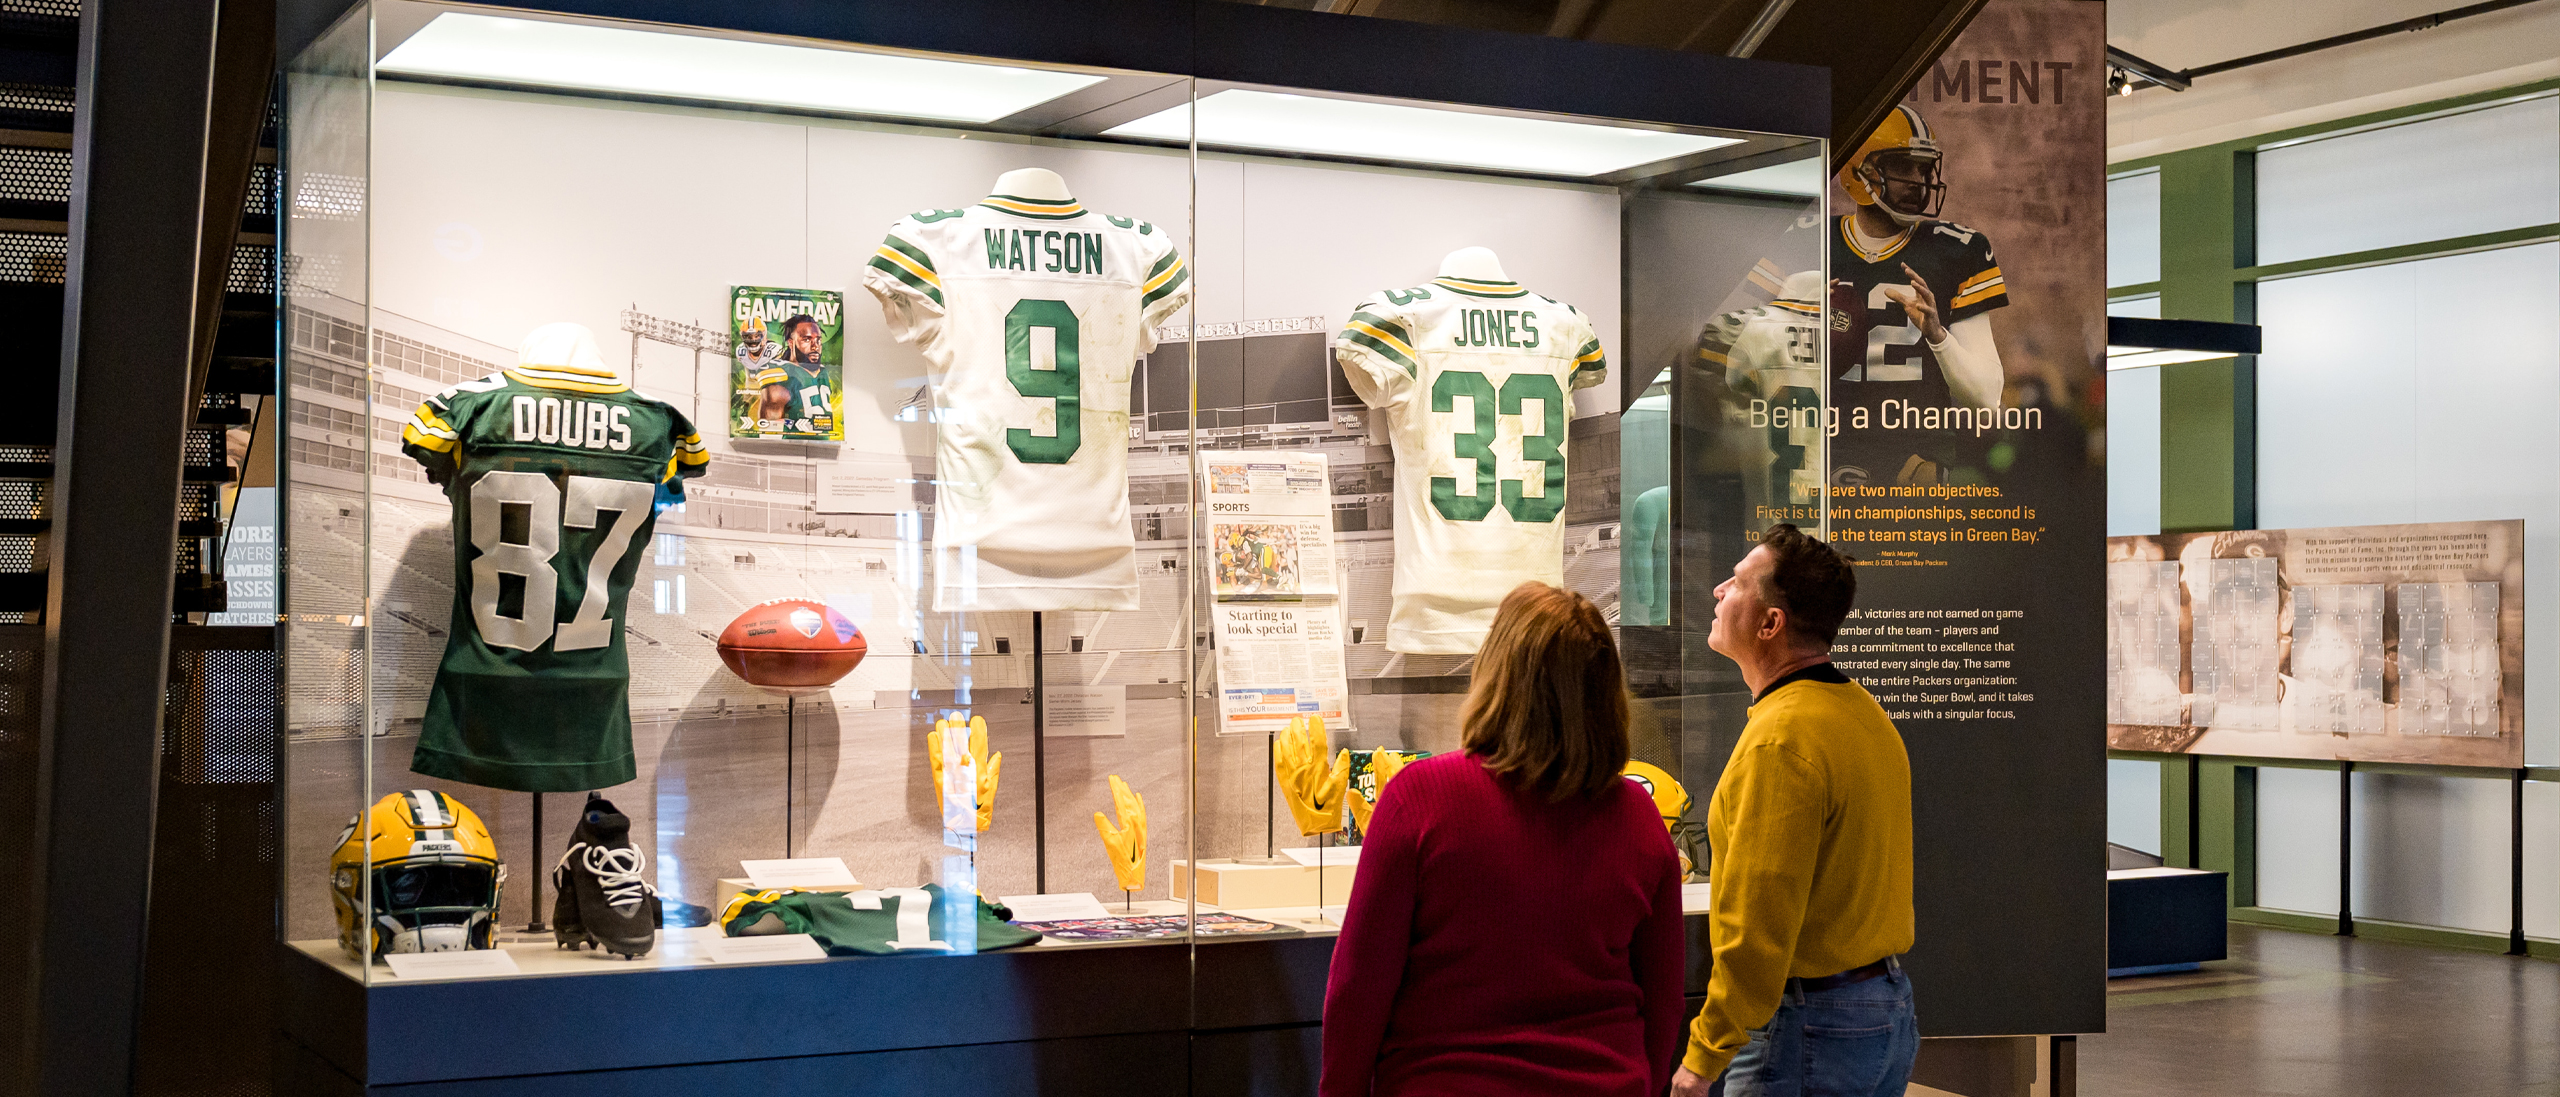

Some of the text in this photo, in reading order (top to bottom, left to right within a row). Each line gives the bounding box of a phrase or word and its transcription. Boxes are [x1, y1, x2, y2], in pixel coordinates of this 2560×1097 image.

[1909, 59, 2073, 105] MENT
[984, 228, 1103, 275] WATSON
[735, 296, 840, 326] GAMEDAY
[1254, 318, 1301, 334] FIELD
[1454, 308, 1540, 349] JONES
[1004, 298, 1081, 465] 9
[513, 395, 632, 451] DOUBS
[1750, 398, 2042, 438] Being a Champion
[1430, 370, 1566, 523] 33
[1859, 484, 1886, 498] two
[1889, 483, 1925, 498] main
[1928, 483, 2004, 501] objectives.
[1212, 503, 1250, 513] SPORTS
[1756, 505, 1789, 520] First
[1792, 505, 1804, 520] is
[1829, 505, 1851, 520] win
[1854, 505, 1966, 523] championships,
[1970, 505, 2021, 520] second
[2024, 505, 2036, 520] is
[229, 526, 274, 544] ORE
[1745, 529, 1760, 542] to
[1841, 528, 1866, 542] the
[1868, 529, 1906, 542] team
[1909, 529, 1947, 545] stays
[1950, 528, 1963, 542] in
[1966, 528, 2008, 542] Green
[2329, 537, 2349, 545] support
[1880, 550, 1919, 559] Mark Murphy
[2315, 547, 2337, 555] Packers
[2338, 546, 2349, 554] Hall
[2387, 545, 2409, 553] through
[2421, 545, 2437, 553] years
[470, 470, 656, 652] 87
[1880, 559, 1894, 568] CEO,
[1894, 559, 1913, 567] Green
[1913, 559, 1925, 568] Bay
[1925, 559, 1948, 567] Packers
[2330, 556, 2351, 564] mission
[2359, 555, 2383, 564] preserve
[2384, 554, 2394, 562] the
[2395, 553, 2415, 562] history
[2435, 552, 2452, 560] Green
[2453, 552, 2464, 561] Bay
[2465, 551, 2489, 560] Packers
[225, 564, 274, 577] AMES
[2340, 565, 2362, 573] national
[2411, 563, 2445, 571] educational
[214, 612, 275, 625] CATCHES
[1229, 610, 1293, 623] Starting to
[1864, 608, 2024, 621] victories are not earned on game
[1227, 622, 1298, 637] look special
[1874, 625, 1885, 636] of
[1887, 625, 1904, 636] the
[1906, 626, 1932, 636] team
[1943, 625, 1979, 637] players
[1980, 625, 1999, 636] and
[1851, 645, 1858, 653] a
[1859, 642, 1925, 653] commitment
[1927, 643, 1938, 653] to
[1940, 642, 1992, 652] excellence
[1994, 642, 2015, 652] that
[1881, 661, 1908, 671] every
[1909, 659, 1940, 671] single
[1941, 659, 1961, 671] day.
[1963, 658, 1982, 669] The
[1983, 660, 2011, 669] same
[1862, 675, 2018, 688] the entire Packers organization:
[1883, 692, 2034, 705] win the Super Bowl, and it takes
[1246, 705, 1267, 713] YOUR
[1913, 708, 2016, 721] with a singular focus,
[422, 844, 452, 852] PACKERS
